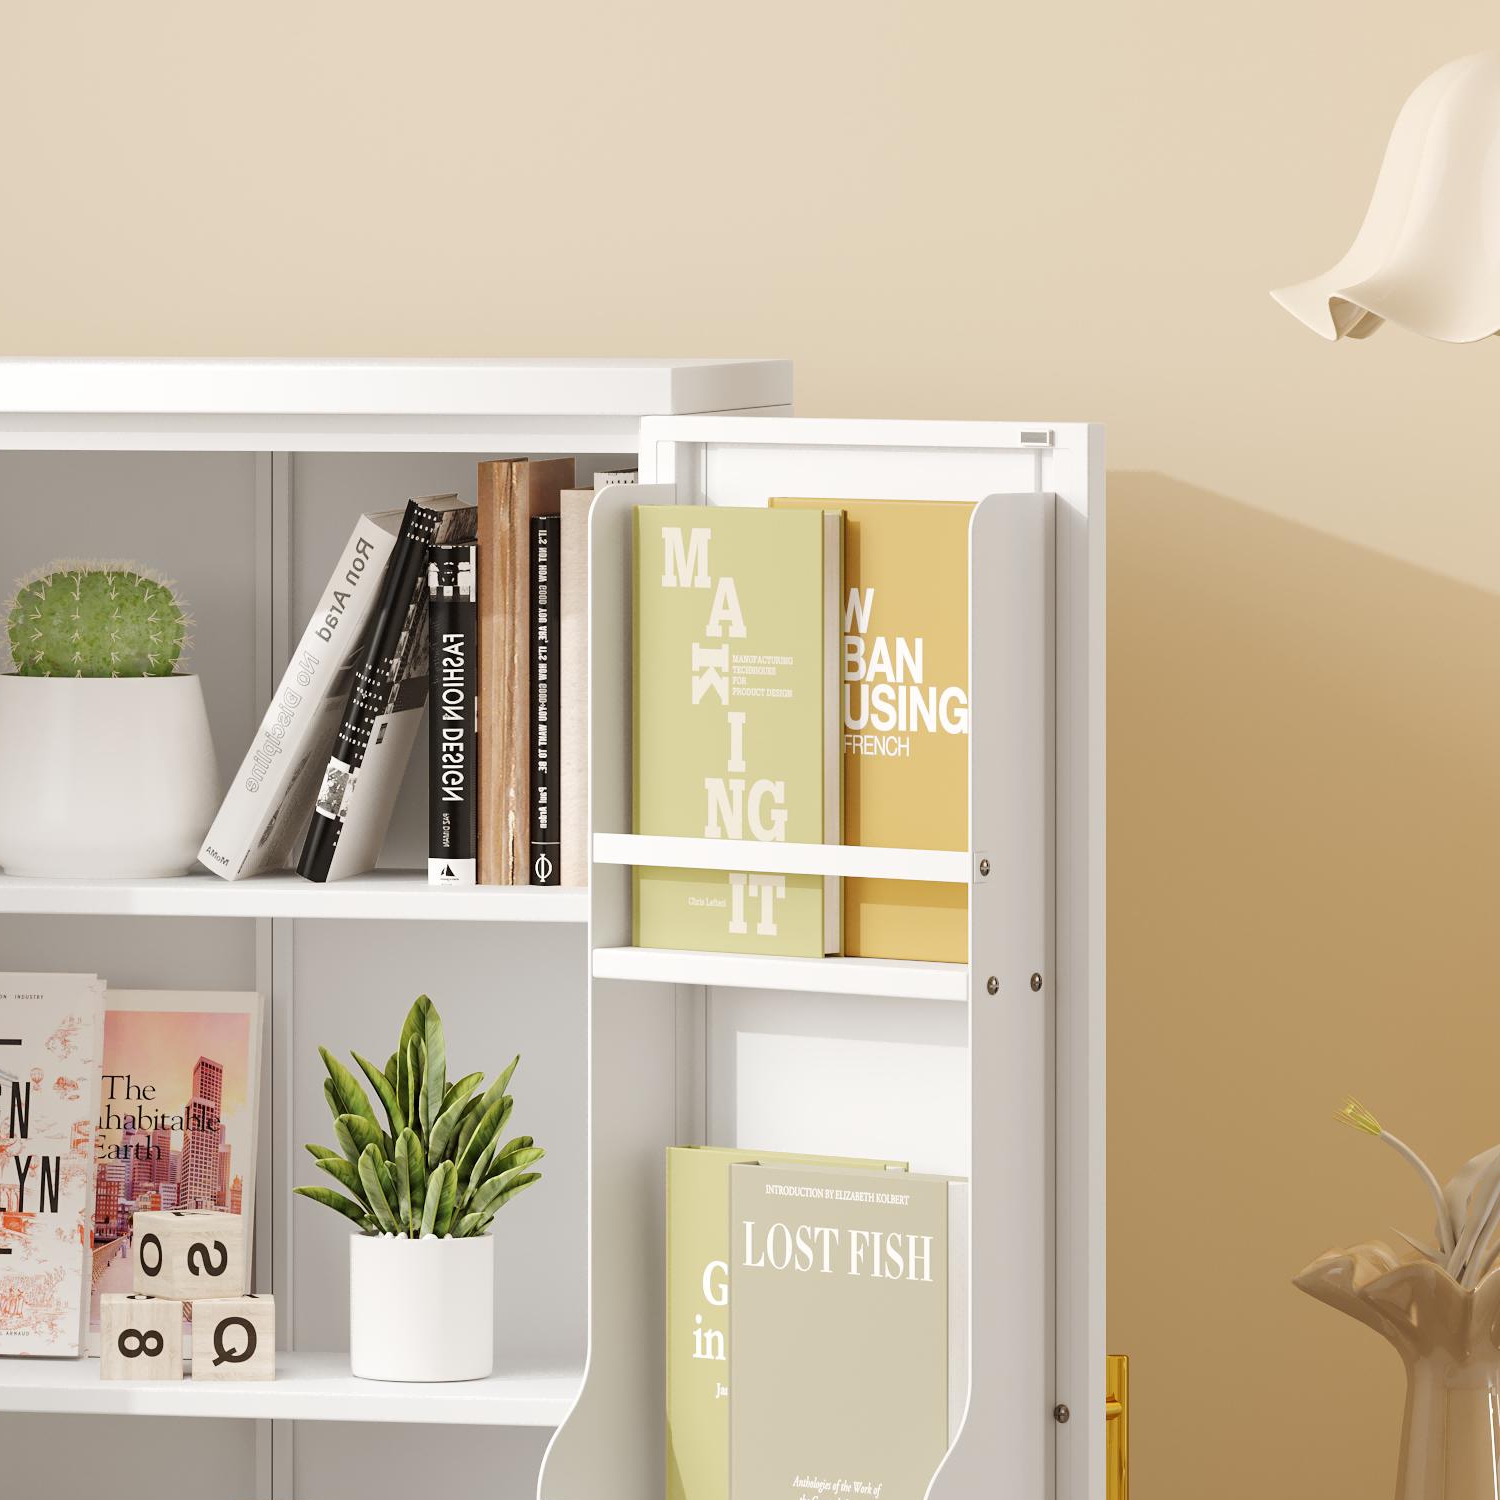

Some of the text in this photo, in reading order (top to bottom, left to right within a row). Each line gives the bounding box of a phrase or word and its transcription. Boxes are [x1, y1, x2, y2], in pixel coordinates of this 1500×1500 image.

[844, 735, 909, 757] FRENCH
[729, 872, 786, 936] IT
[101, 1074, 156, 1101] The
[765, 1184, 910, 1206] INTRODUCTION BY ELIZABETH KOLBERT
[743, 1220, 934, 1283] LOST FISH
[693, 1313, 726, 1361] in
[792, 1475, 883, 1499] Anthologies of the Work of
